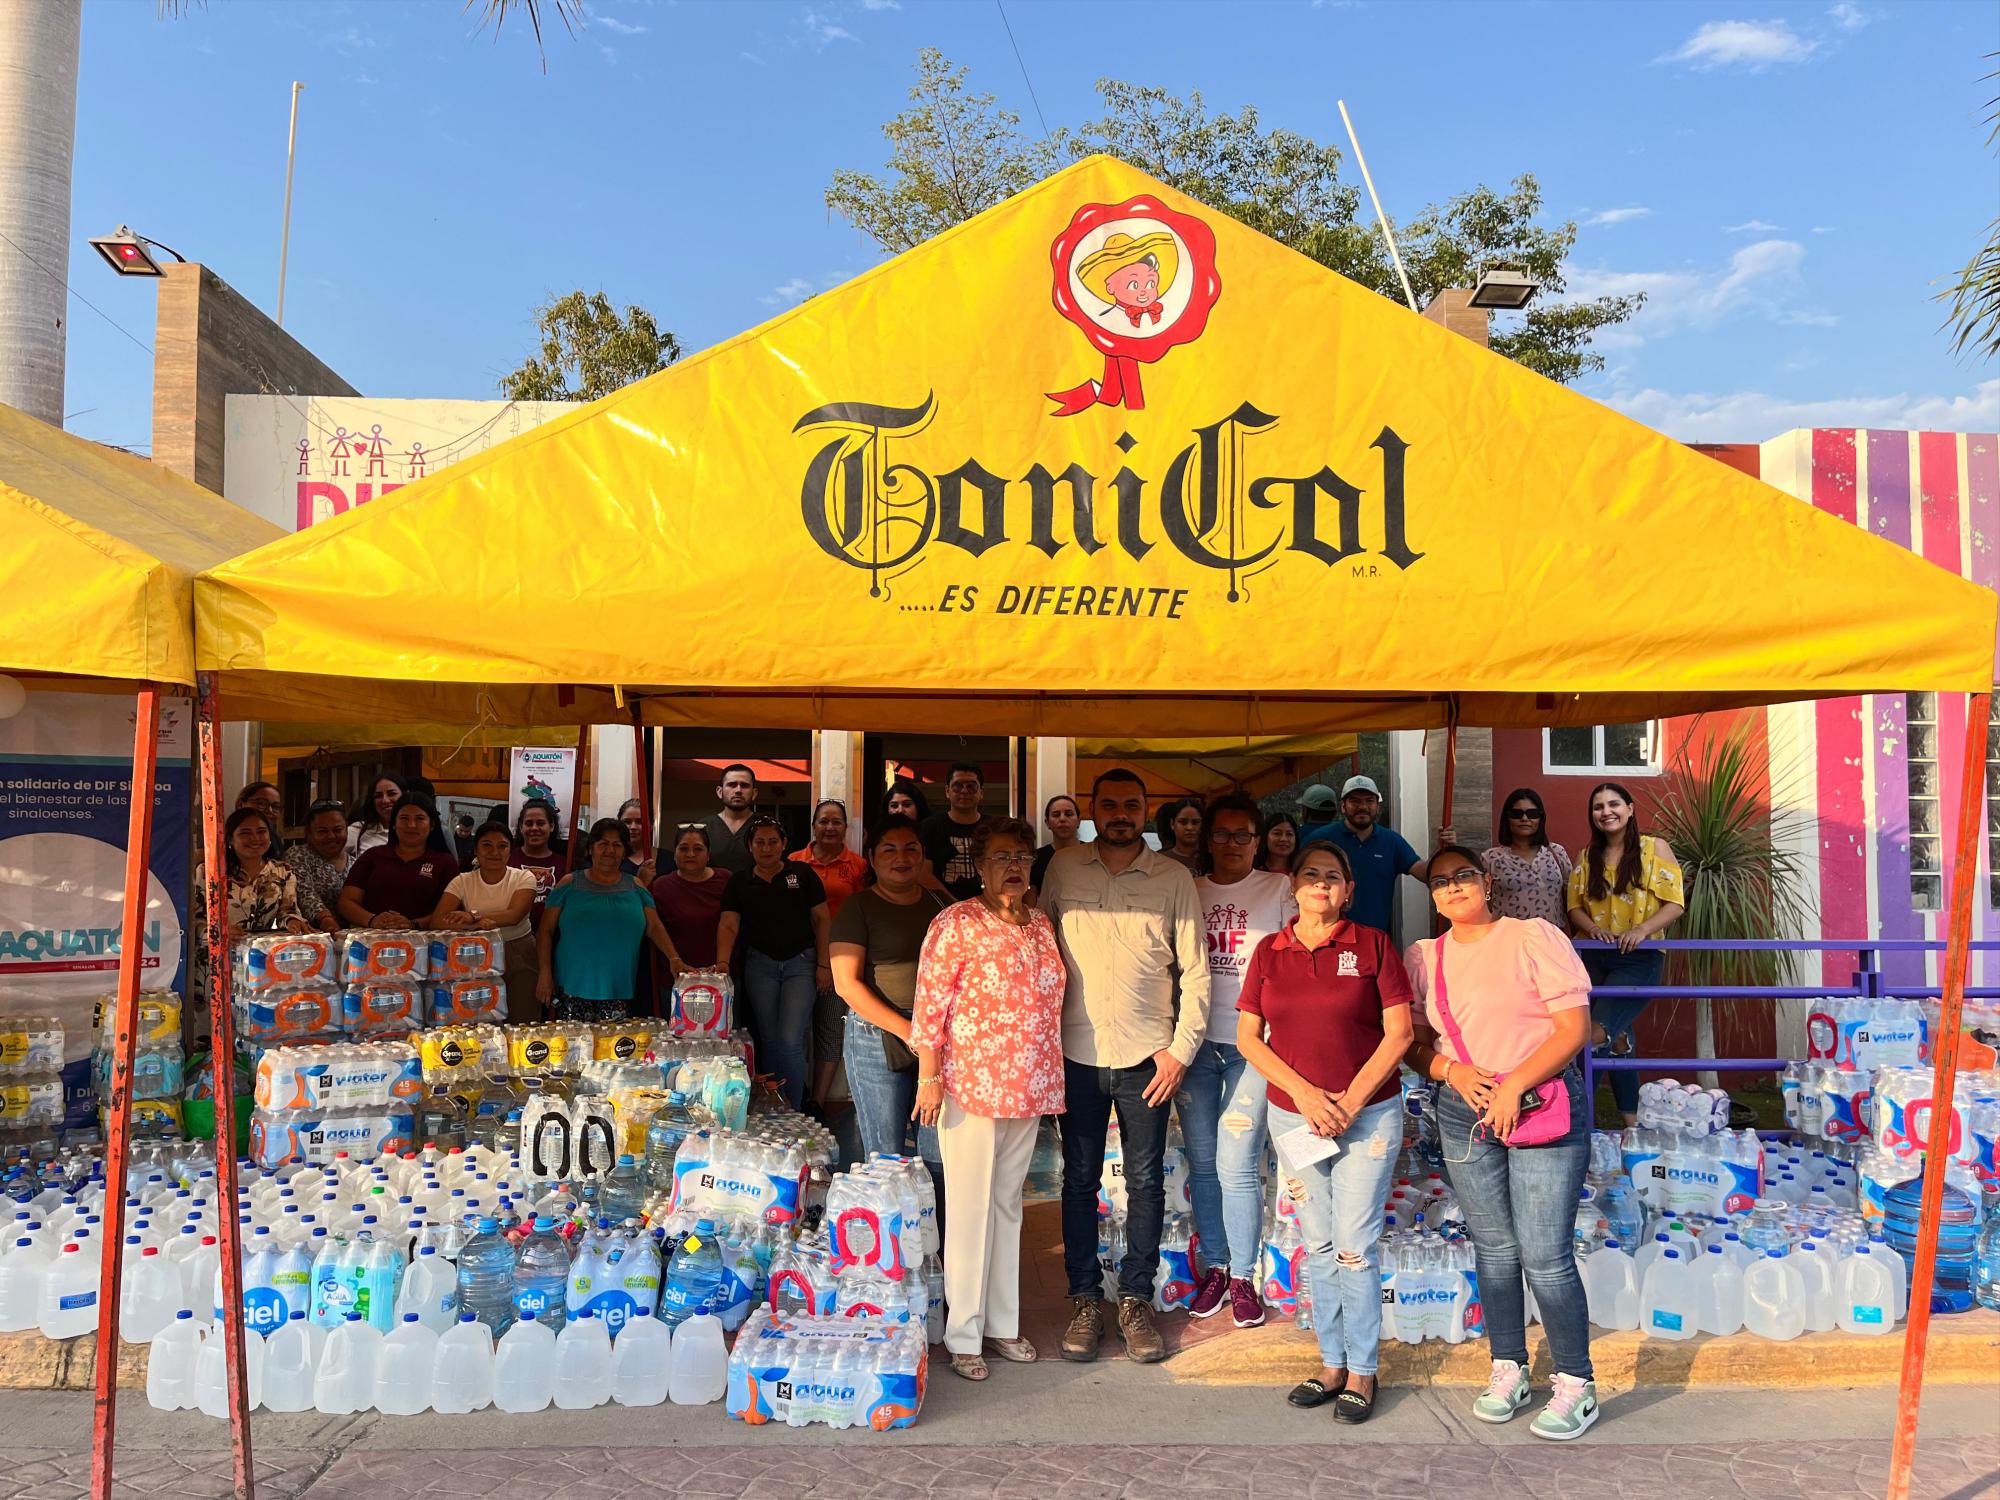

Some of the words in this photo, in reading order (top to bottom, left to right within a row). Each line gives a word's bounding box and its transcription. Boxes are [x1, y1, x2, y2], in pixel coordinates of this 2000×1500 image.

[792, 387, 1427, 602] ToniCol
[1352, 565, 1381, 578] M.R.
[996, 586, 1188, 619] DIFERENTE
[7, 778, 71, 791] solidario
[74, 780, 92, 791] de
[95, 780, 117, 791] DIF
[119, 780, 172, 792] Sioa
[15, 793, 82, 805] bienestar
[86, 794, 104, 805] de
[107, 795, 127, 805] las
[8, 807, 95, 819] sinaloenses.
[1207, 931, 1247, 954] DIF
[1872, 1031, 1914, 1042] water
[335, 1071, 388, 1087] water
[398, 1080, 410, 1089] 45
[326, 1127, 371, 1144] agua
[387, 1138, 399, 1146] 45
[1667, 1166, 1719, 1185] agua
[716, 1178, 762, 1197] agua
[1727, 1196, 1740, 1207] 18
[765, 1209, 778, 1219] 18
[665, 1286, 687, 1305] ciel
[1165, 1284, 1177, 1296] 18
[1397, 1288, 1459, 1305] water
[519, 1293, 545, 1310] ciel
[795, 1384, 856, 1404] agua
[878, 1406, 893, 1417] 45
